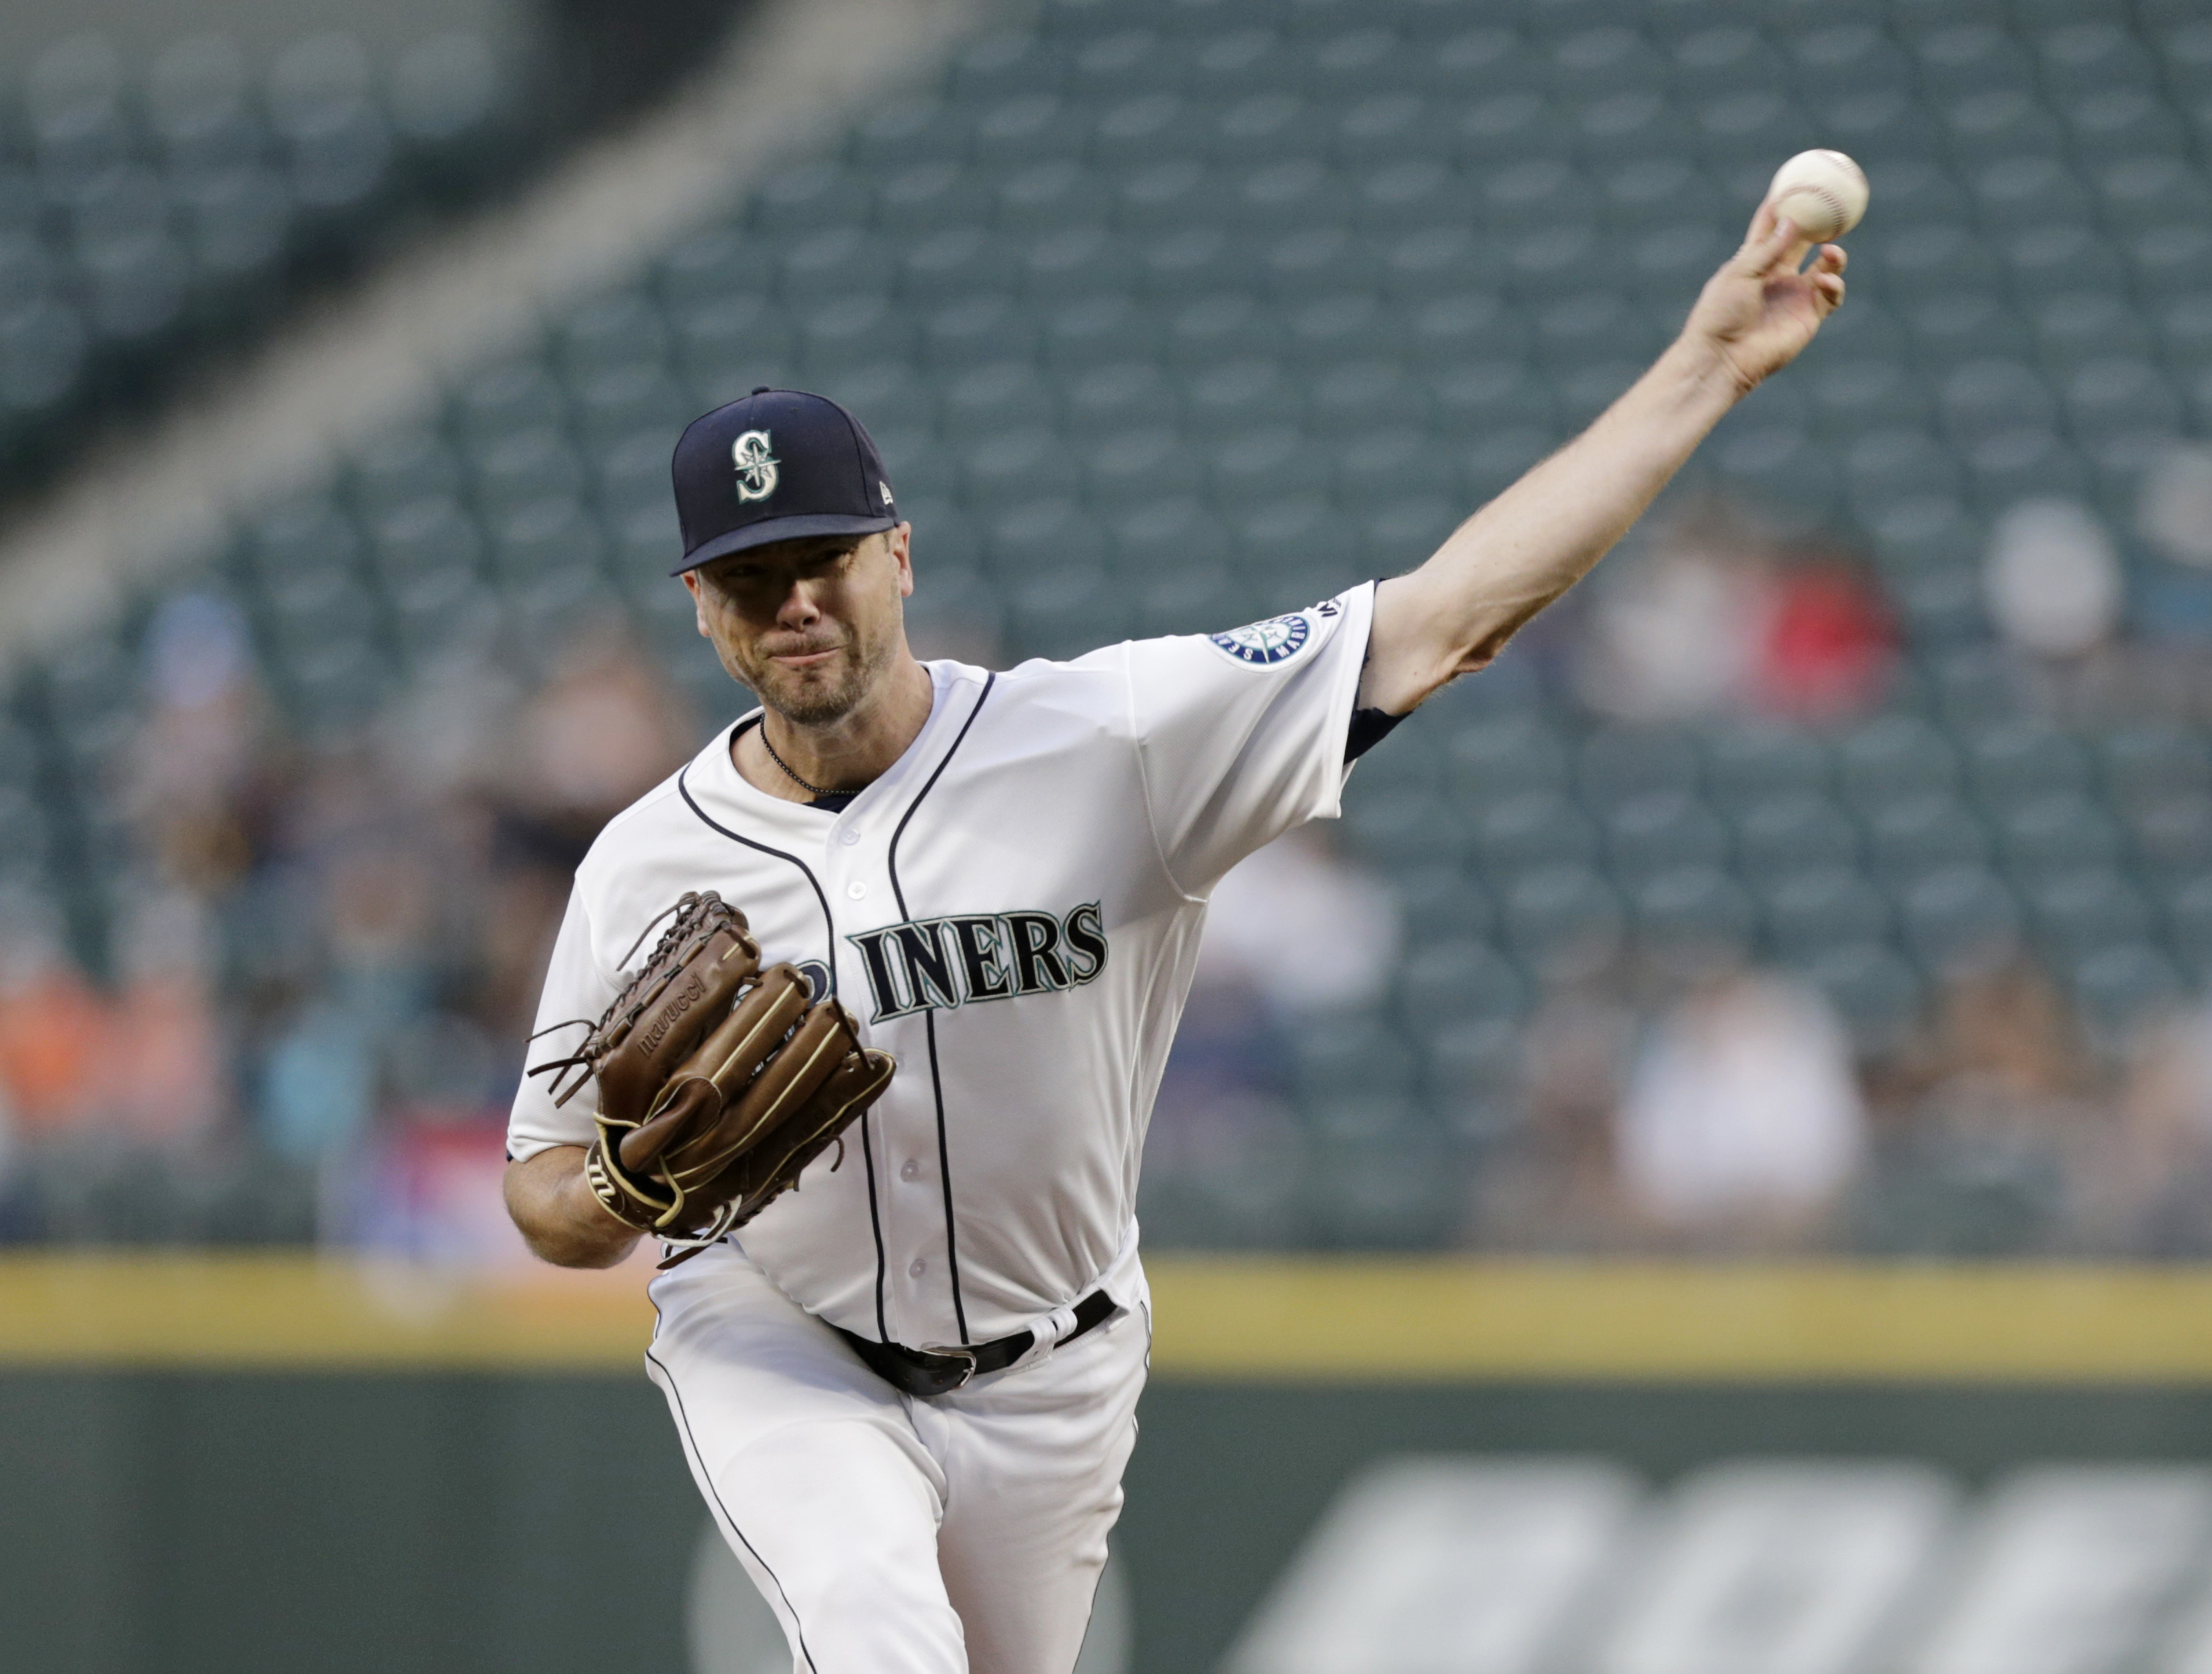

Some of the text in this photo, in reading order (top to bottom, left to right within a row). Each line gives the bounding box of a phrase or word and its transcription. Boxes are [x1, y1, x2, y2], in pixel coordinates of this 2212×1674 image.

[732, 429, 780, 505] S
[796, 899, 1109, 1025] INERS
[637, 972, 706, 1058] marucci
